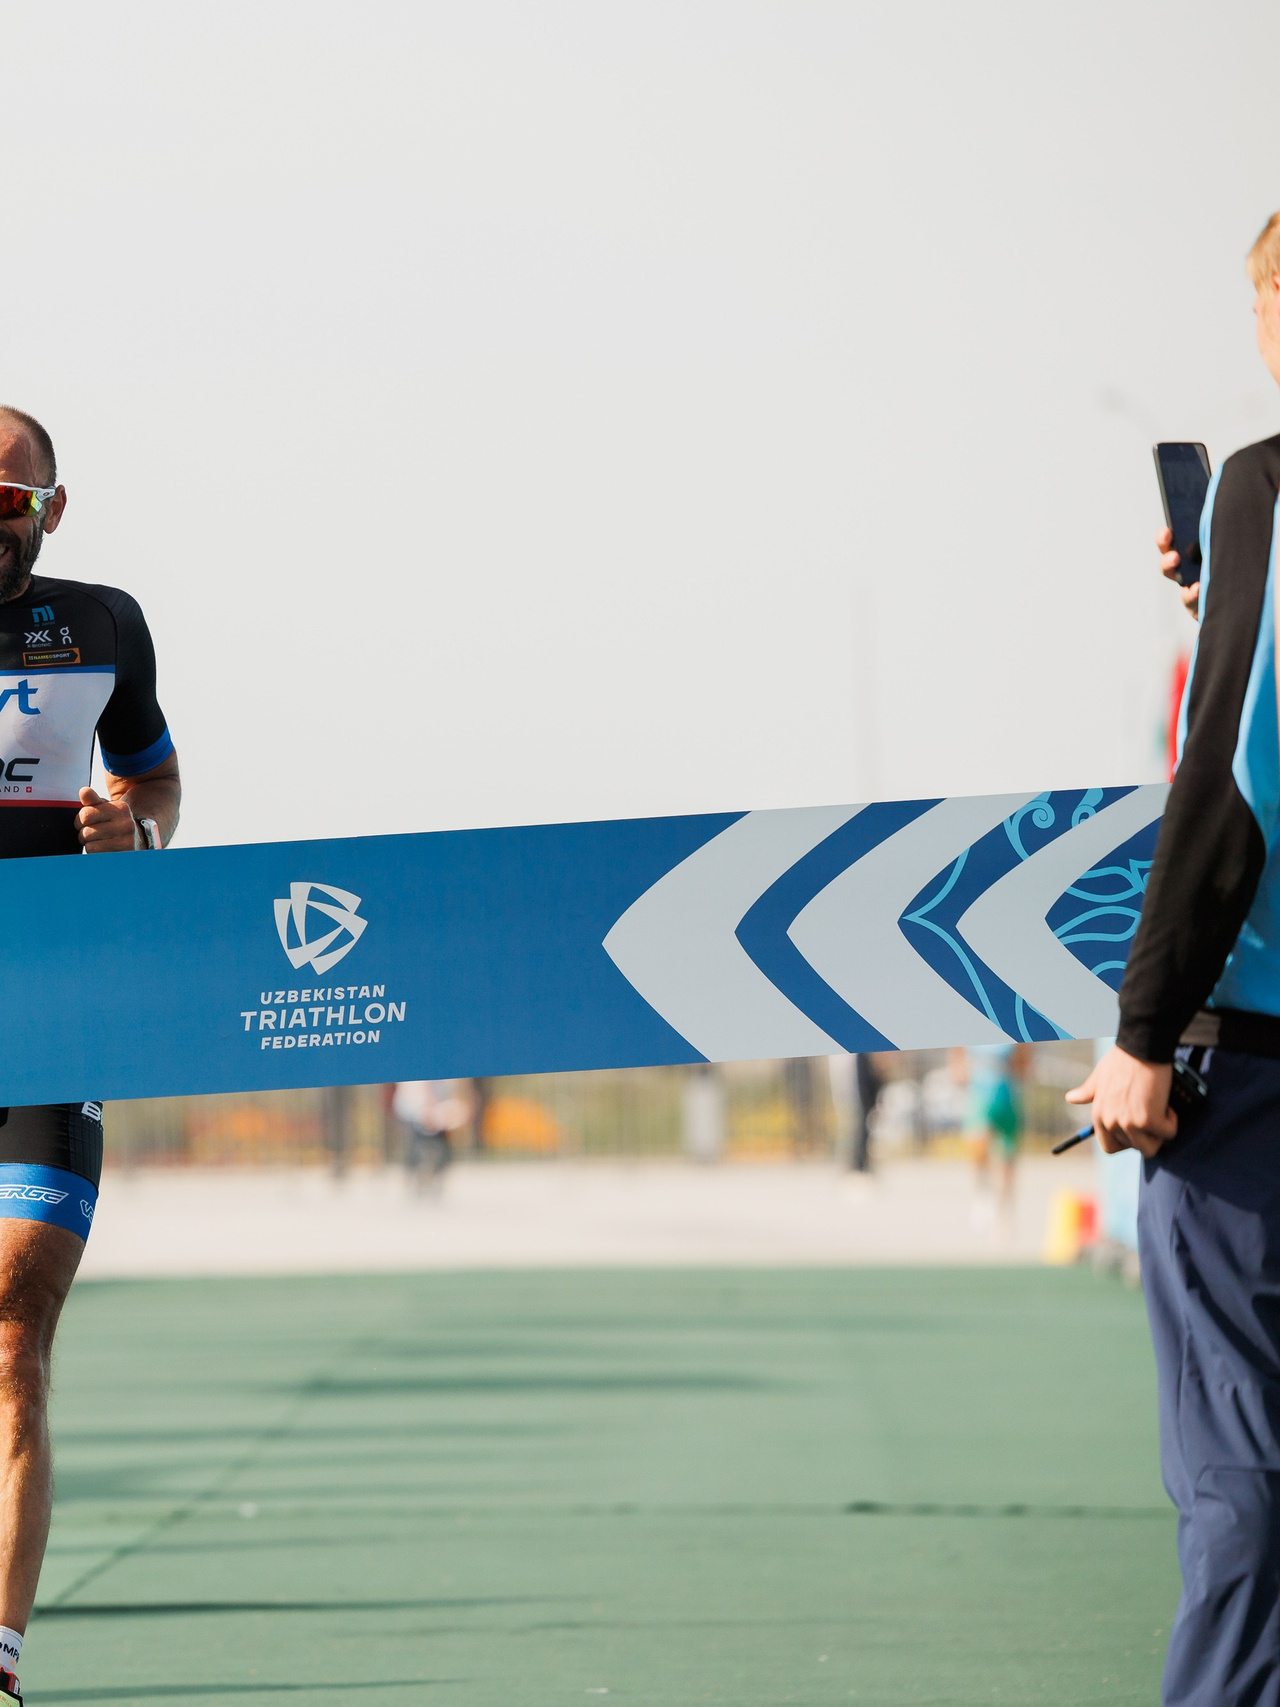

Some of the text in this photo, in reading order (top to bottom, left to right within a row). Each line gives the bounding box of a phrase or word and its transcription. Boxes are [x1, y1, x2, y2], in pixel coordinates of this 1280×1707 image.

[260, 984, 385, 1005] UZBEKISTAN
[240, 1001, 407, 1032] TRIATHLON
[261, 1030, 381, 1050] FEDERATION
